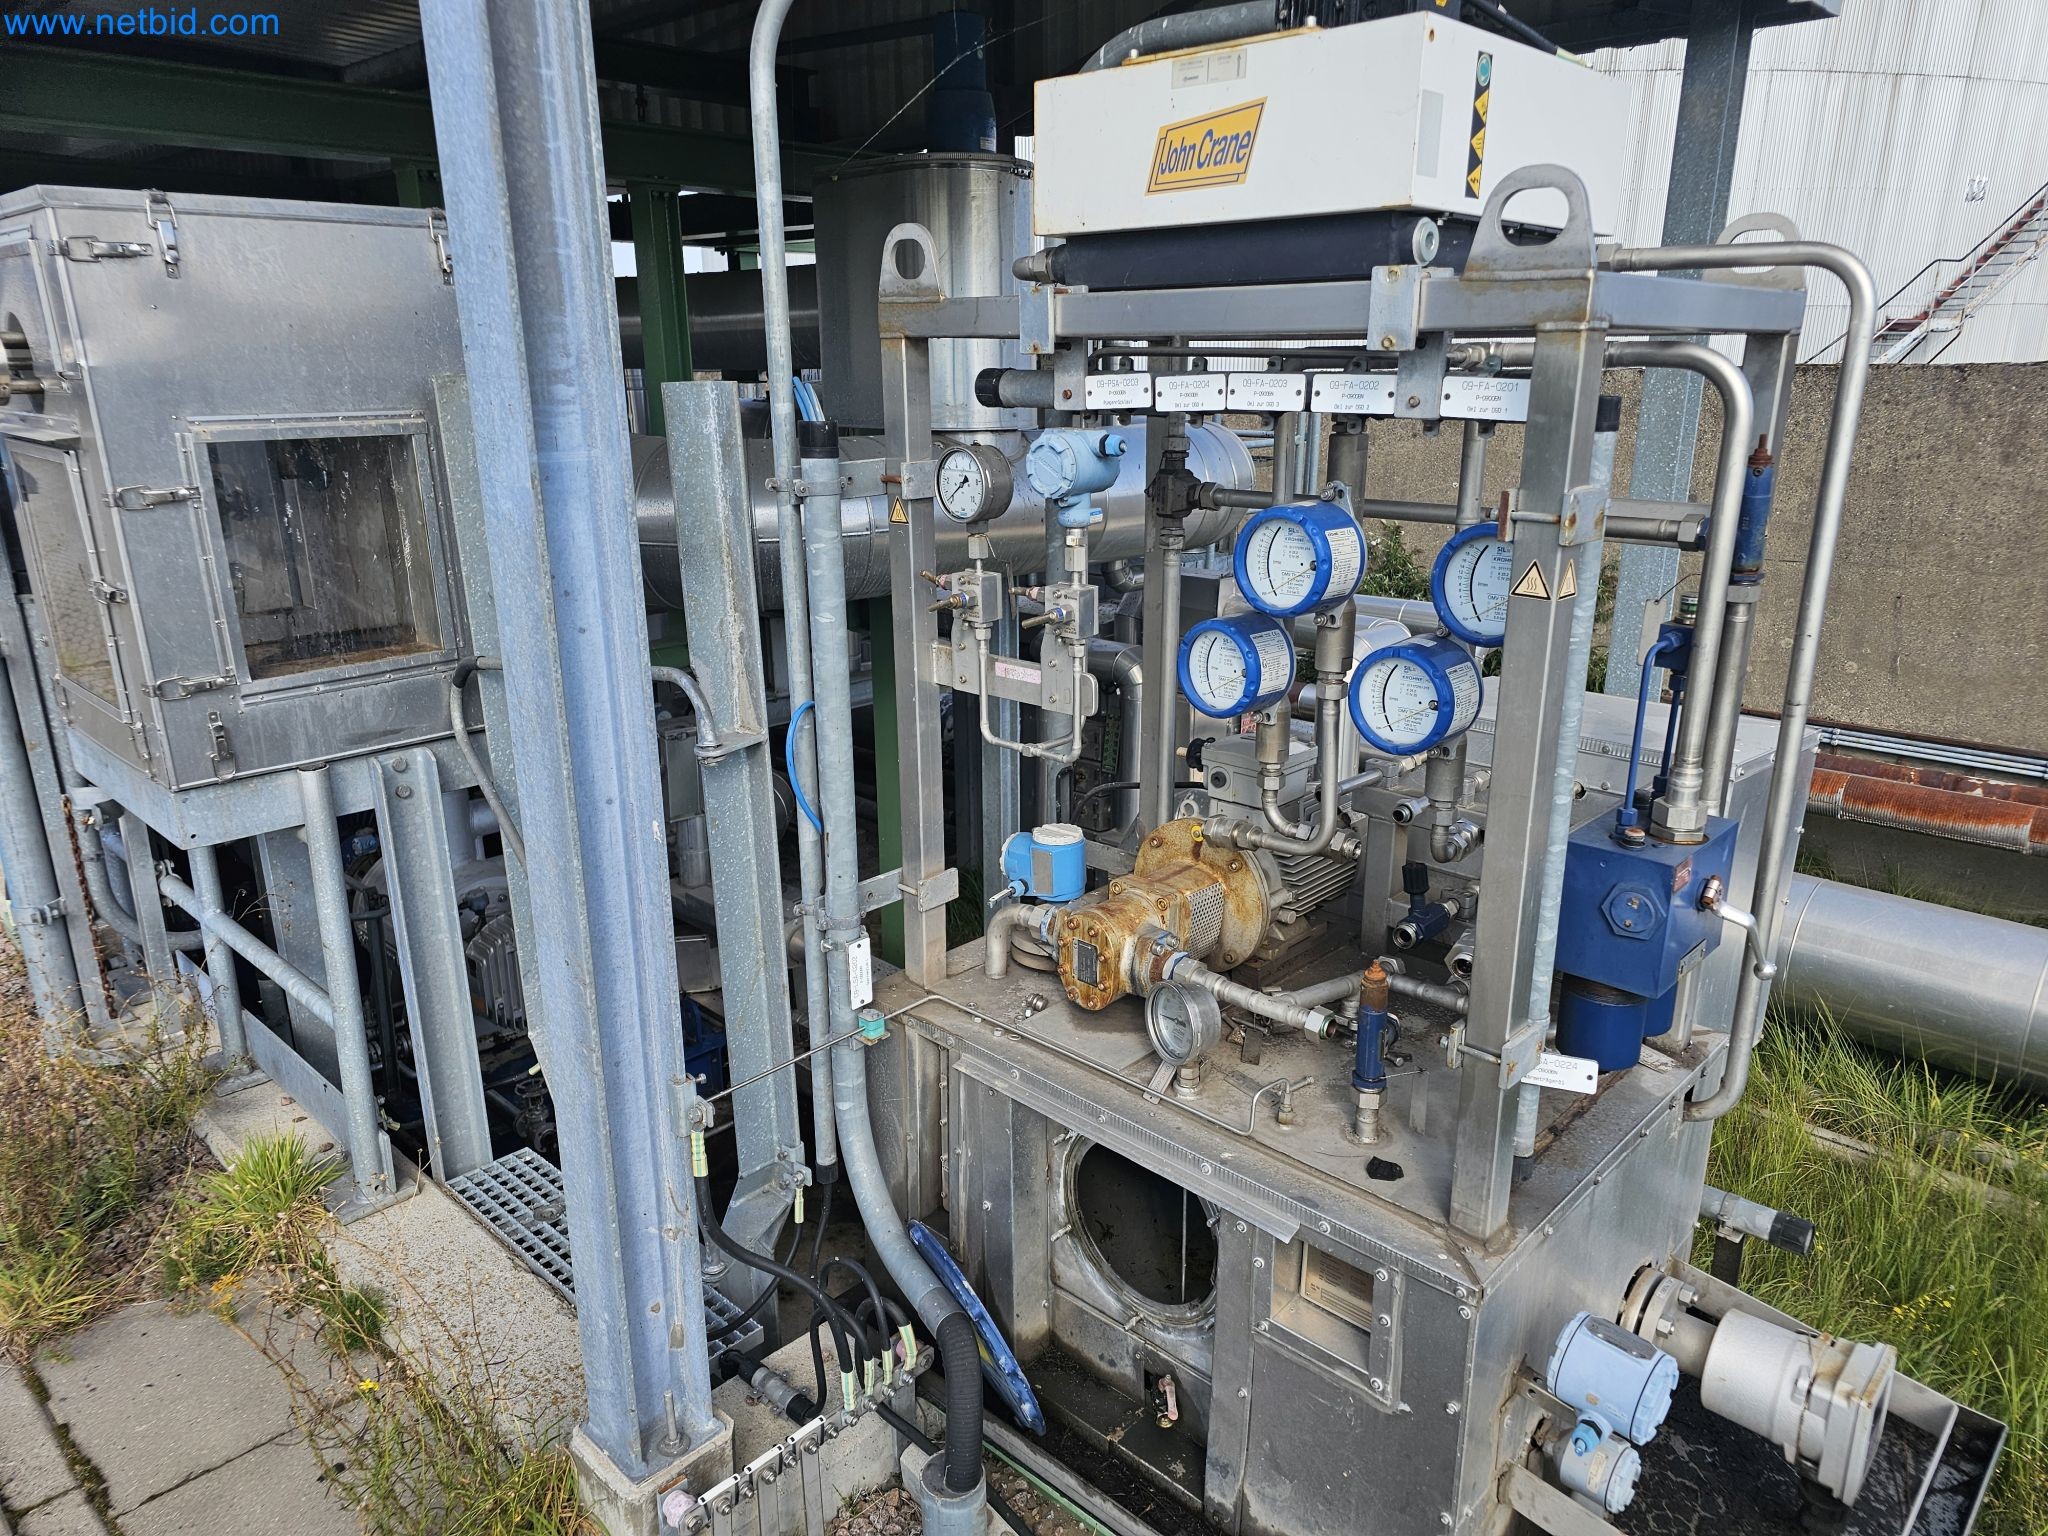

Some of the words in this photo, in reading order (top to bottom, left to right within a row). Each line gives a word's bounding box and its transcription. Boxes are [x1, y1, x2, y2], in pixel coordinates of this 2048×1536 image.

[1160, 136, 1196, 175] John
[1197, 128, 1252, 169] Crane
[1097, 378, 1139, 388] 09-PSA-0203
[1168, 379, 1210, 390] 09-FA-0204
[1242, 378, 1288, 388] 09-FA-0203
[1329, 380, 1380, 390] 09-FA-0202
[1461, 380, 1519, 392] 09-FA-0201
